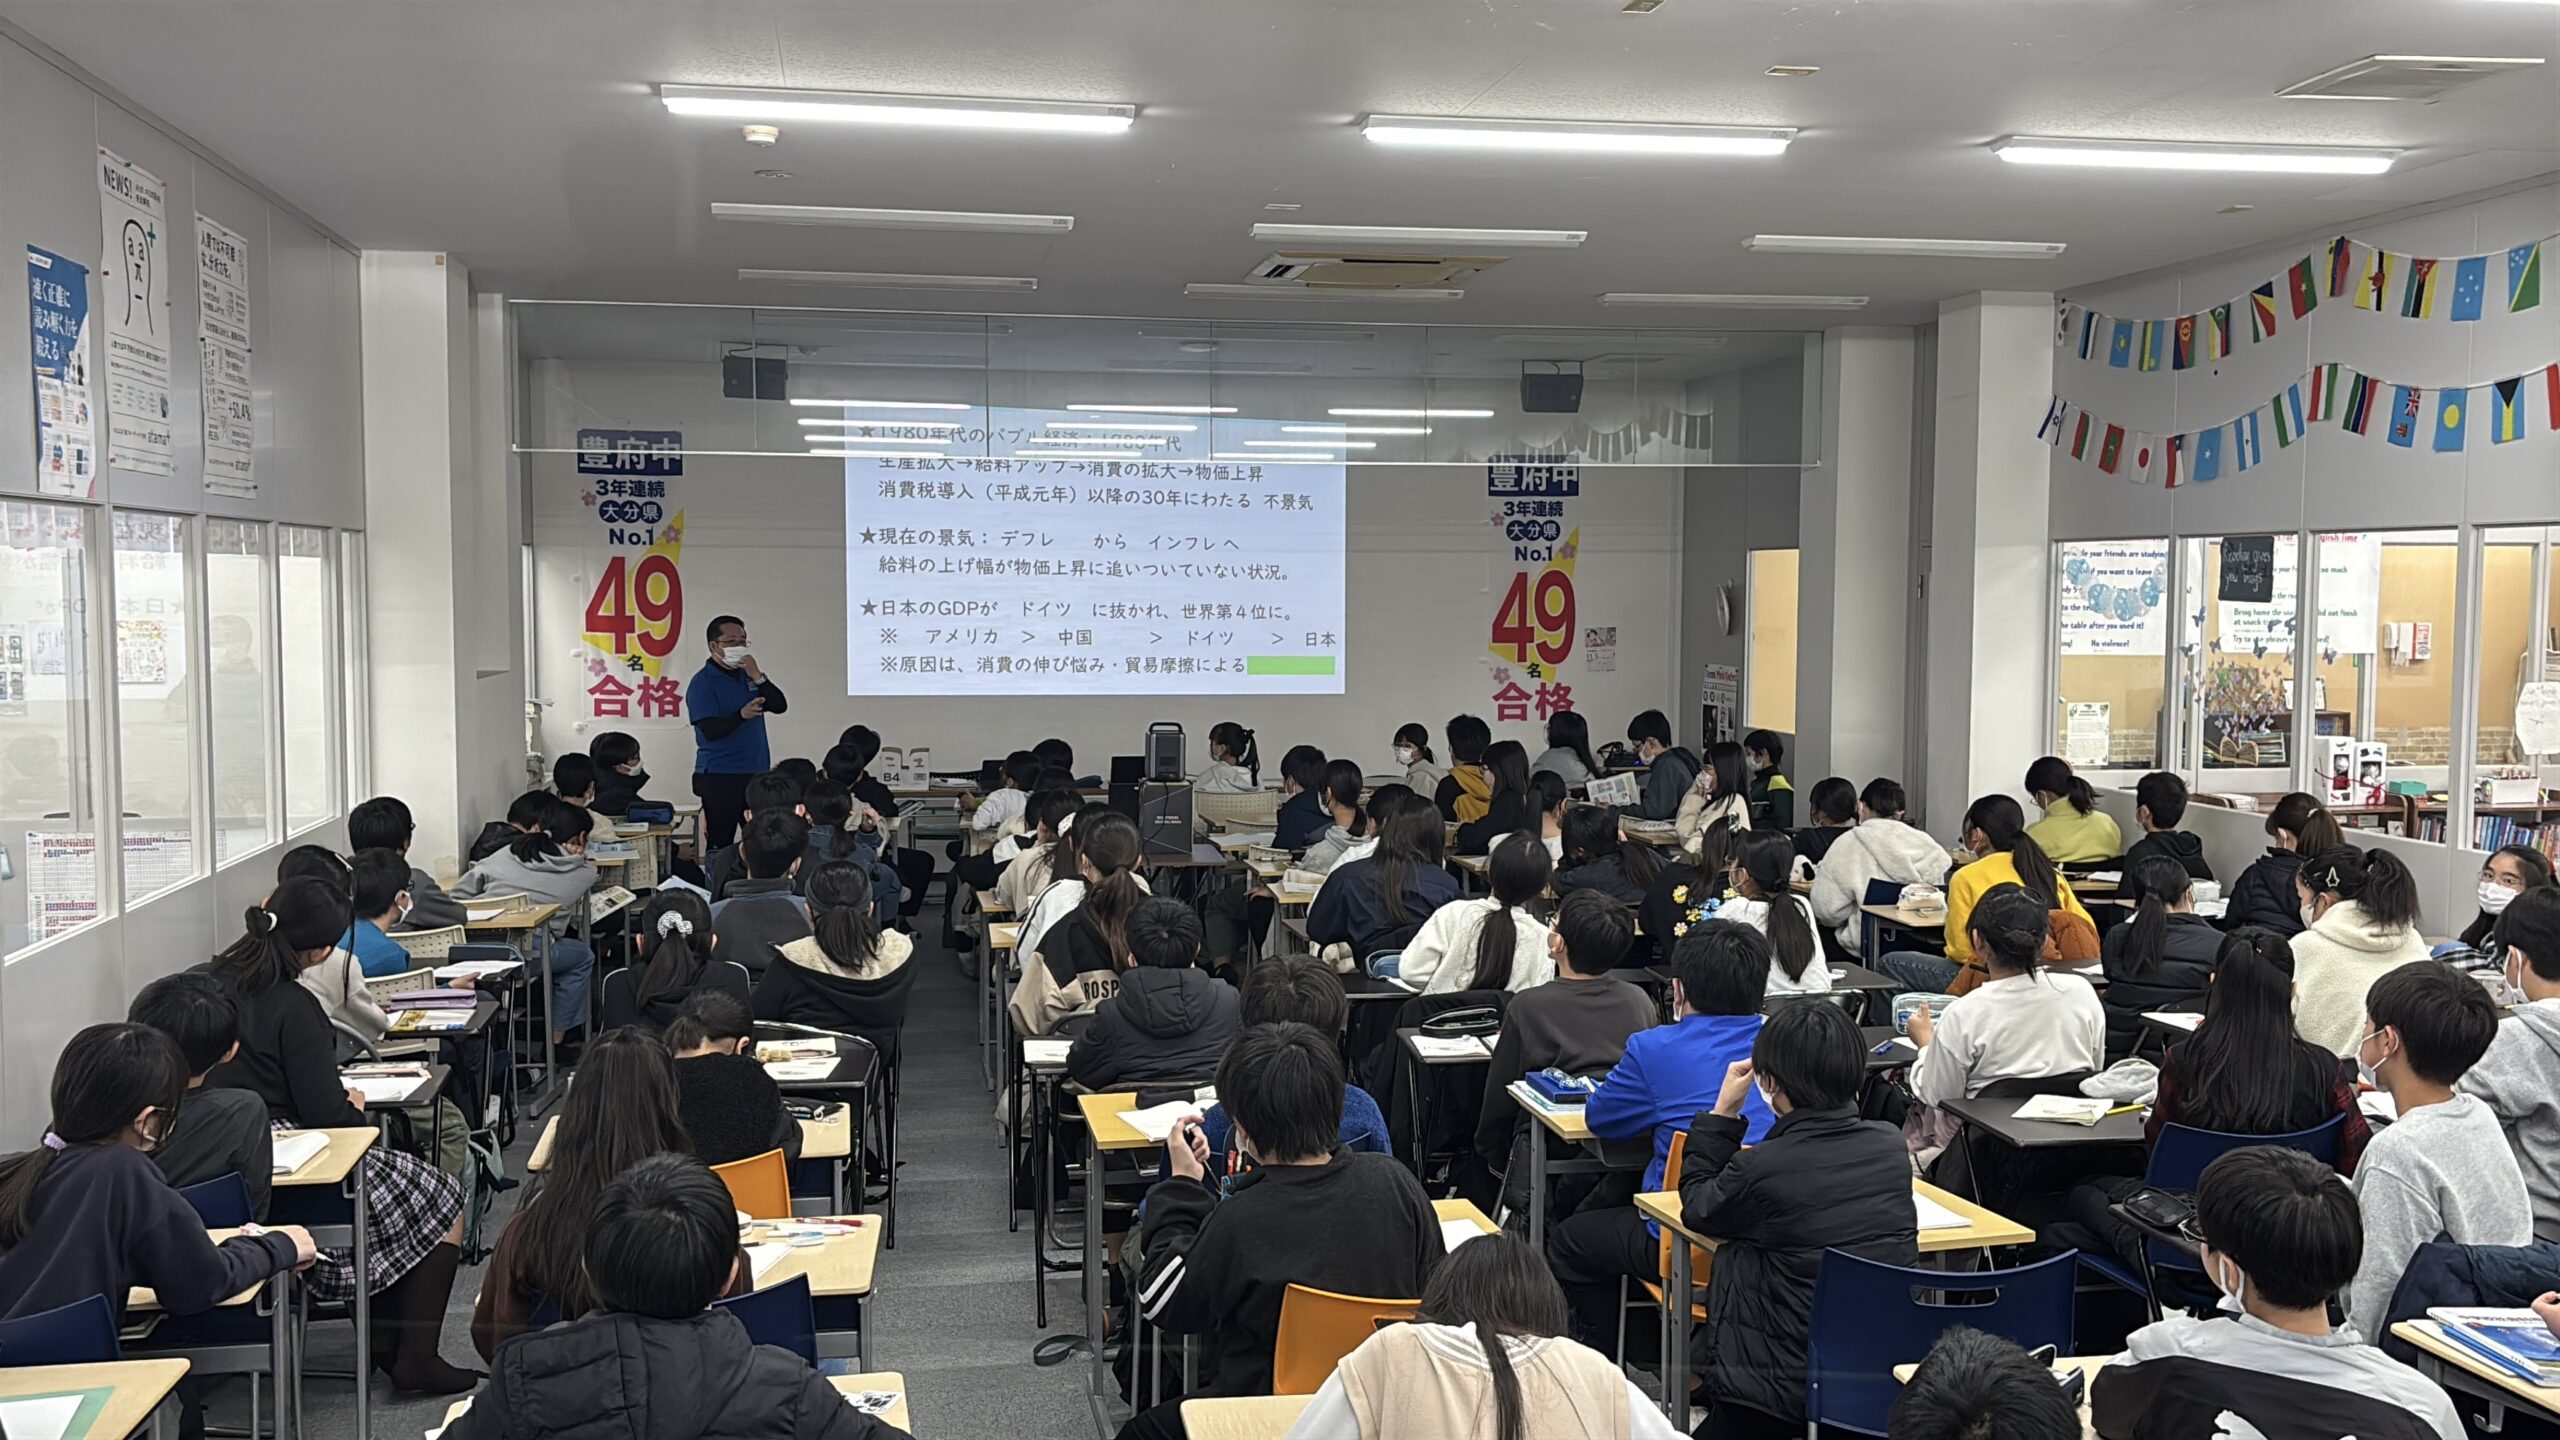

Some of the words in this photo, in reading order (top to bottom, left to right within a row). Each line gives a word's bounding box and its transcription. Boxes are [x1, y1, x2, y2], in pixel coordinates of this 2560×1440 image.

[103, 165, 133, 199] NEWS!
[579, 435, 681, 471] 豊府中
[1489, 458, 1578, 492] 豊府中
[596, 479, 665, 497] 3年連続
[878, 480, 1251, 511] 消費税導入（平成元年）以降の30年にわたる
[1264, 493, 1314, 512] 不景気
[600, 501, 662, 522] 大分県
[1503, 501, 1563, 517] 3年連続
[609, 526, 654, 546] No.1
[1508, 521, 1560, 540] 大分県
[1001, 532, 1055, 548] デフレ
[1094, 533, 1127, 551] から
[1515, 545, 1553, 561] No.1
[2089, 551, 2103, 559] your
[2104, 549, 2127, 557] friends
[878, 557, 1290, 582] 給料の上げ幅が物価上昇に追いついていない状況。
[2096, 569, 2107, 578] you
[2136, 566, 2152, 575] leave
[2225, 572, 2238, 592] you
[585, 555, 684, 657] 49
[1021, 601, 1072, 618] ドイツ
[2234, 608, 2251, 617] Bring
[2253, 608, 2270, 616] home
[2272, 608, 2282, 616] the
[1491, 570, 1576, 665] 49
[2070, 621, 2087, 629] table
[2088, 620, 2105, 629] after
[2107, 623, 2117, 631] you
[2119, 621, 2135, 629] used
[2243, 618, 2261, 626] snack
[926, 628, 1000, 645] アメリカ
[1058, 628, 1093, 647] 中国
[1185, 629, 1235, 647] ドイツ
[1305, 631, 1336, 648] 日本
[2101, 639, 2129, 647] violence!
[2233, 635, 2242, 643] Try
[2266, 635, 2288, 644] phrases
[627, 654, 644, 672] 名
[880, 655, 1246, 675] ※原因は、消費の伸び悩み・貿易摩擦による
[1527, 662, 1542, 679] 名
[588, 675, 684, 718] 合格
[1493, 682, 1574, 722] 合格
[884, 773, 899, 782] B4
